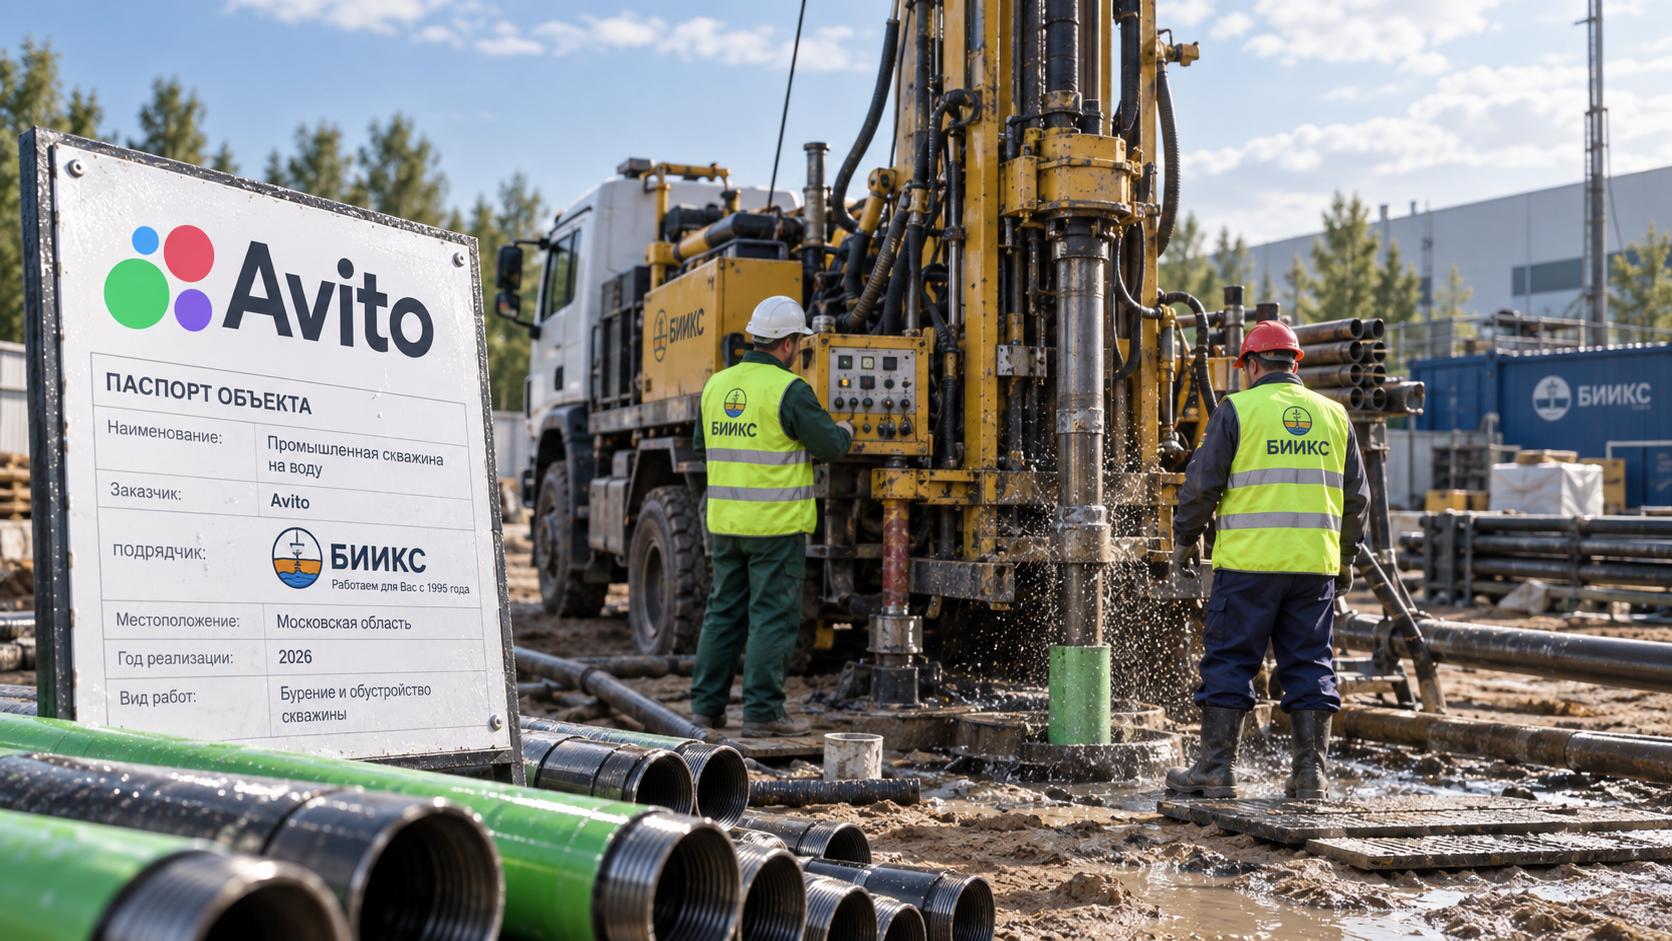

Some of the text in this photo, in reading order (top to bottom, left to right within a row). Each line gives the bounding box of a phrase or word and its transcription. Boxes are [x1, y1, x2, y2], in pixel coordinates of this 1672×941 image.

[222, 240, 434, 358] Avito
[669, 308, 705, 344] БИИКС
[105, 371, 312, 415] ПАСПОРТ ОБЪЕКТА
[1577, 382, 1652, 407] БИИКС
[107, 420, 223, 445] Наименование:
[711, 421, 757, 438] БИИКС
[267, 435, 444, 467] Промышленная скважина
[1266, 439, 1330, 457] БИИКС
[268, 460, 323, 479] на воду
[110, 482, 182, 500] Заказчик:
[270, 493, 310, 510] Avito
[113, 543, 206, 562] подрядчик:
[330, 543, 427, 574] БИИКС
[331, 579, 379, 591] Работаем
[380, 583, 398, 592] для
[400, 582, 418, 592] Вас
[427, 583, 448, 593] 1995
[450, 585, 470, 595] года
[116, 611, 240, 629] Местоположение:
[276, 613, 412, 630] Московская область
[118, 650, 234, 668] Год реализации:
[278, 649, 313, 665] 2026
[119, 690, 197, 707] Вид работ:
[280, 683, 432, 703] Бурение и обустройство
[281, 709, 348, 723] скважины
